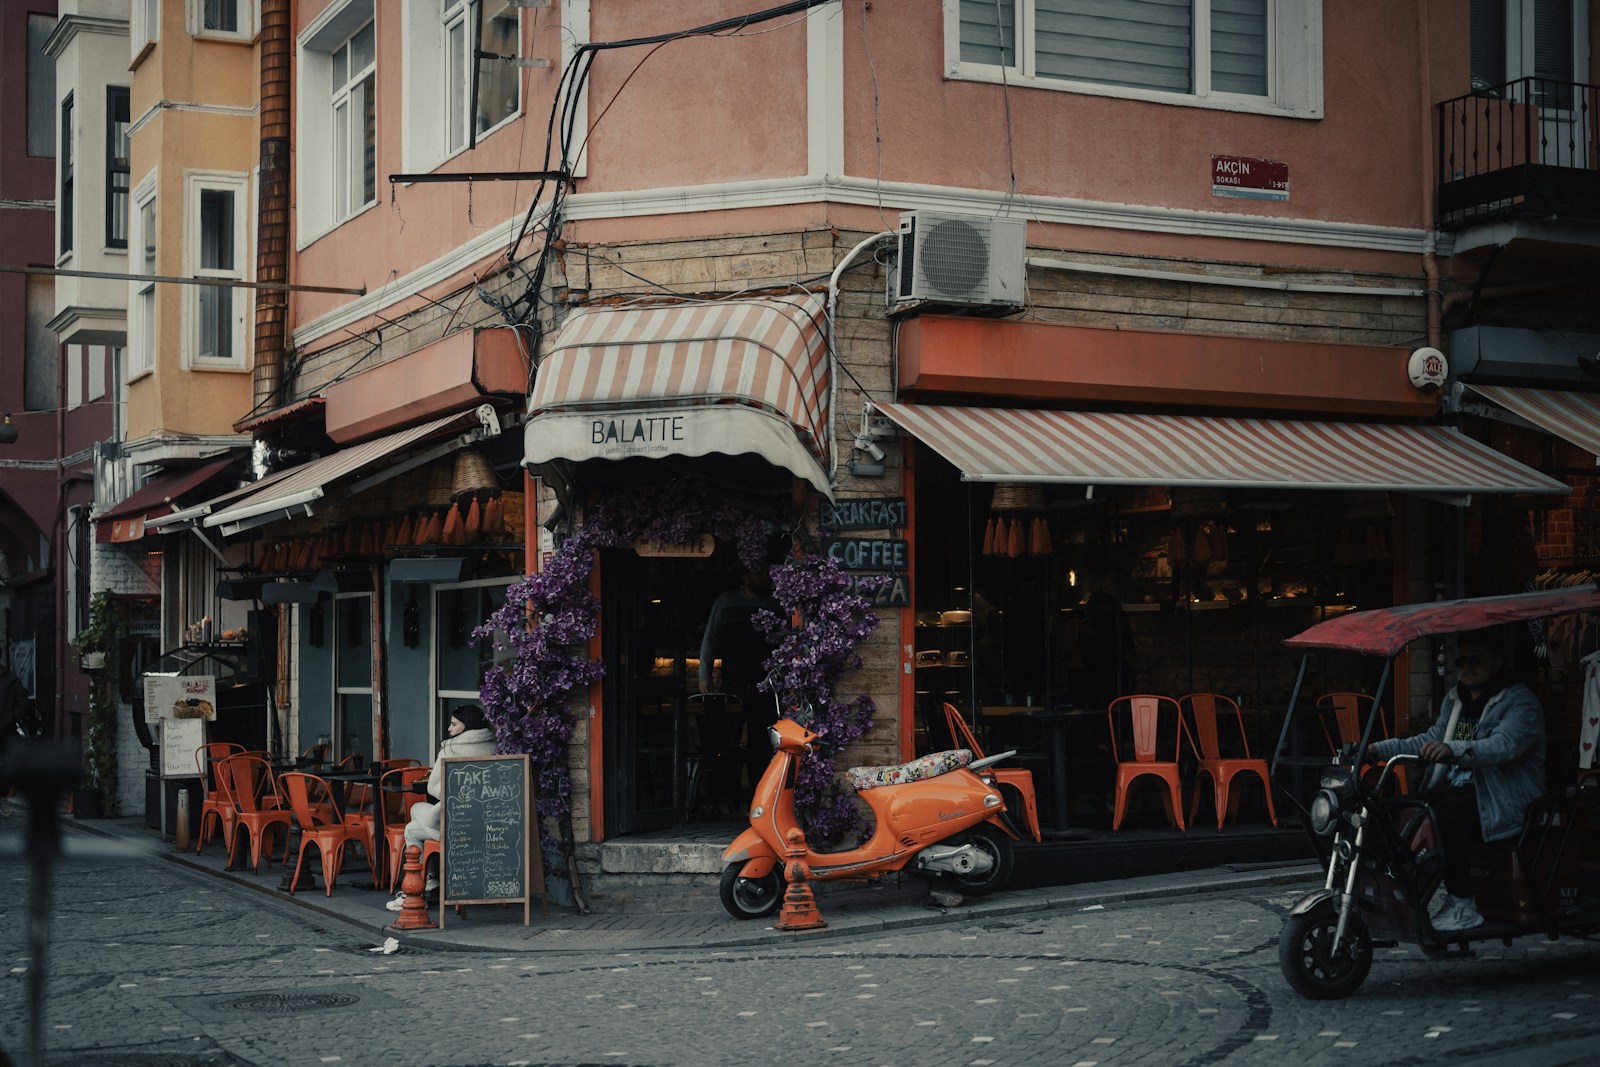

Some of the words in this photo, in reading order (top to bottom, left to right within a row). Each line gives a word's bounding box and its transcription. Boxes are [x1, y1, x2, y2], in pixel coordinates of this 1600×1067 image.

[1216, 160, 1250, 176] AKÇİN
[1424, 362, 1442, 373] KALE
[592, 416, 684, 444] BALATTE
[820, 501, 907, 526] BREAKFAST
[828, 541, 904, 568] COFFEE
[454, 770, 491, 785] TAKE
[481, 784, 516, 799] AWAY
